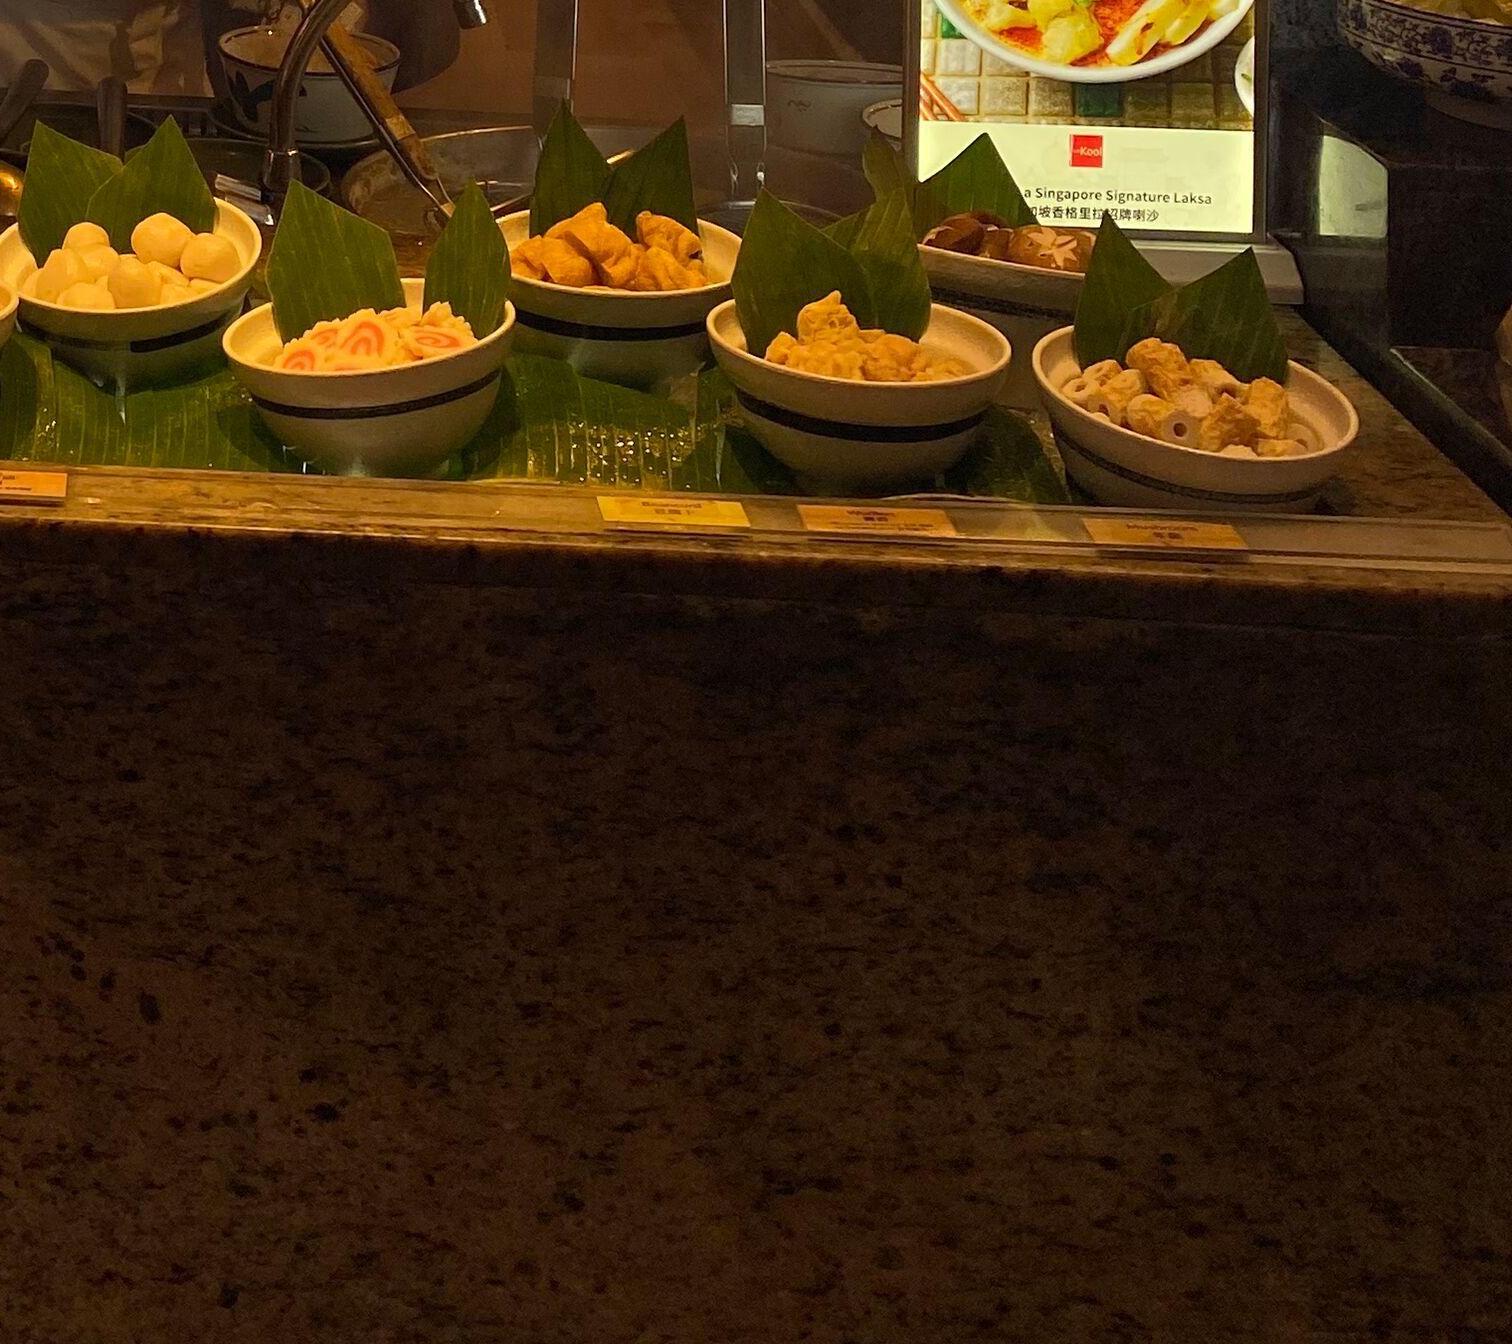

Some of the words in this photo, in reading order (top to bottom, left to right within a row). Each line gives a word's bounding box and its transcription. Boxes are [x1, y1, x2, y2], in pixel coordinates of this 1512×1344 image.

[1035, 187, 1102, 202] Singapore
[1105, 189, 1170, 204] Signature
[1173, 192, 1212, 205] Laksa
